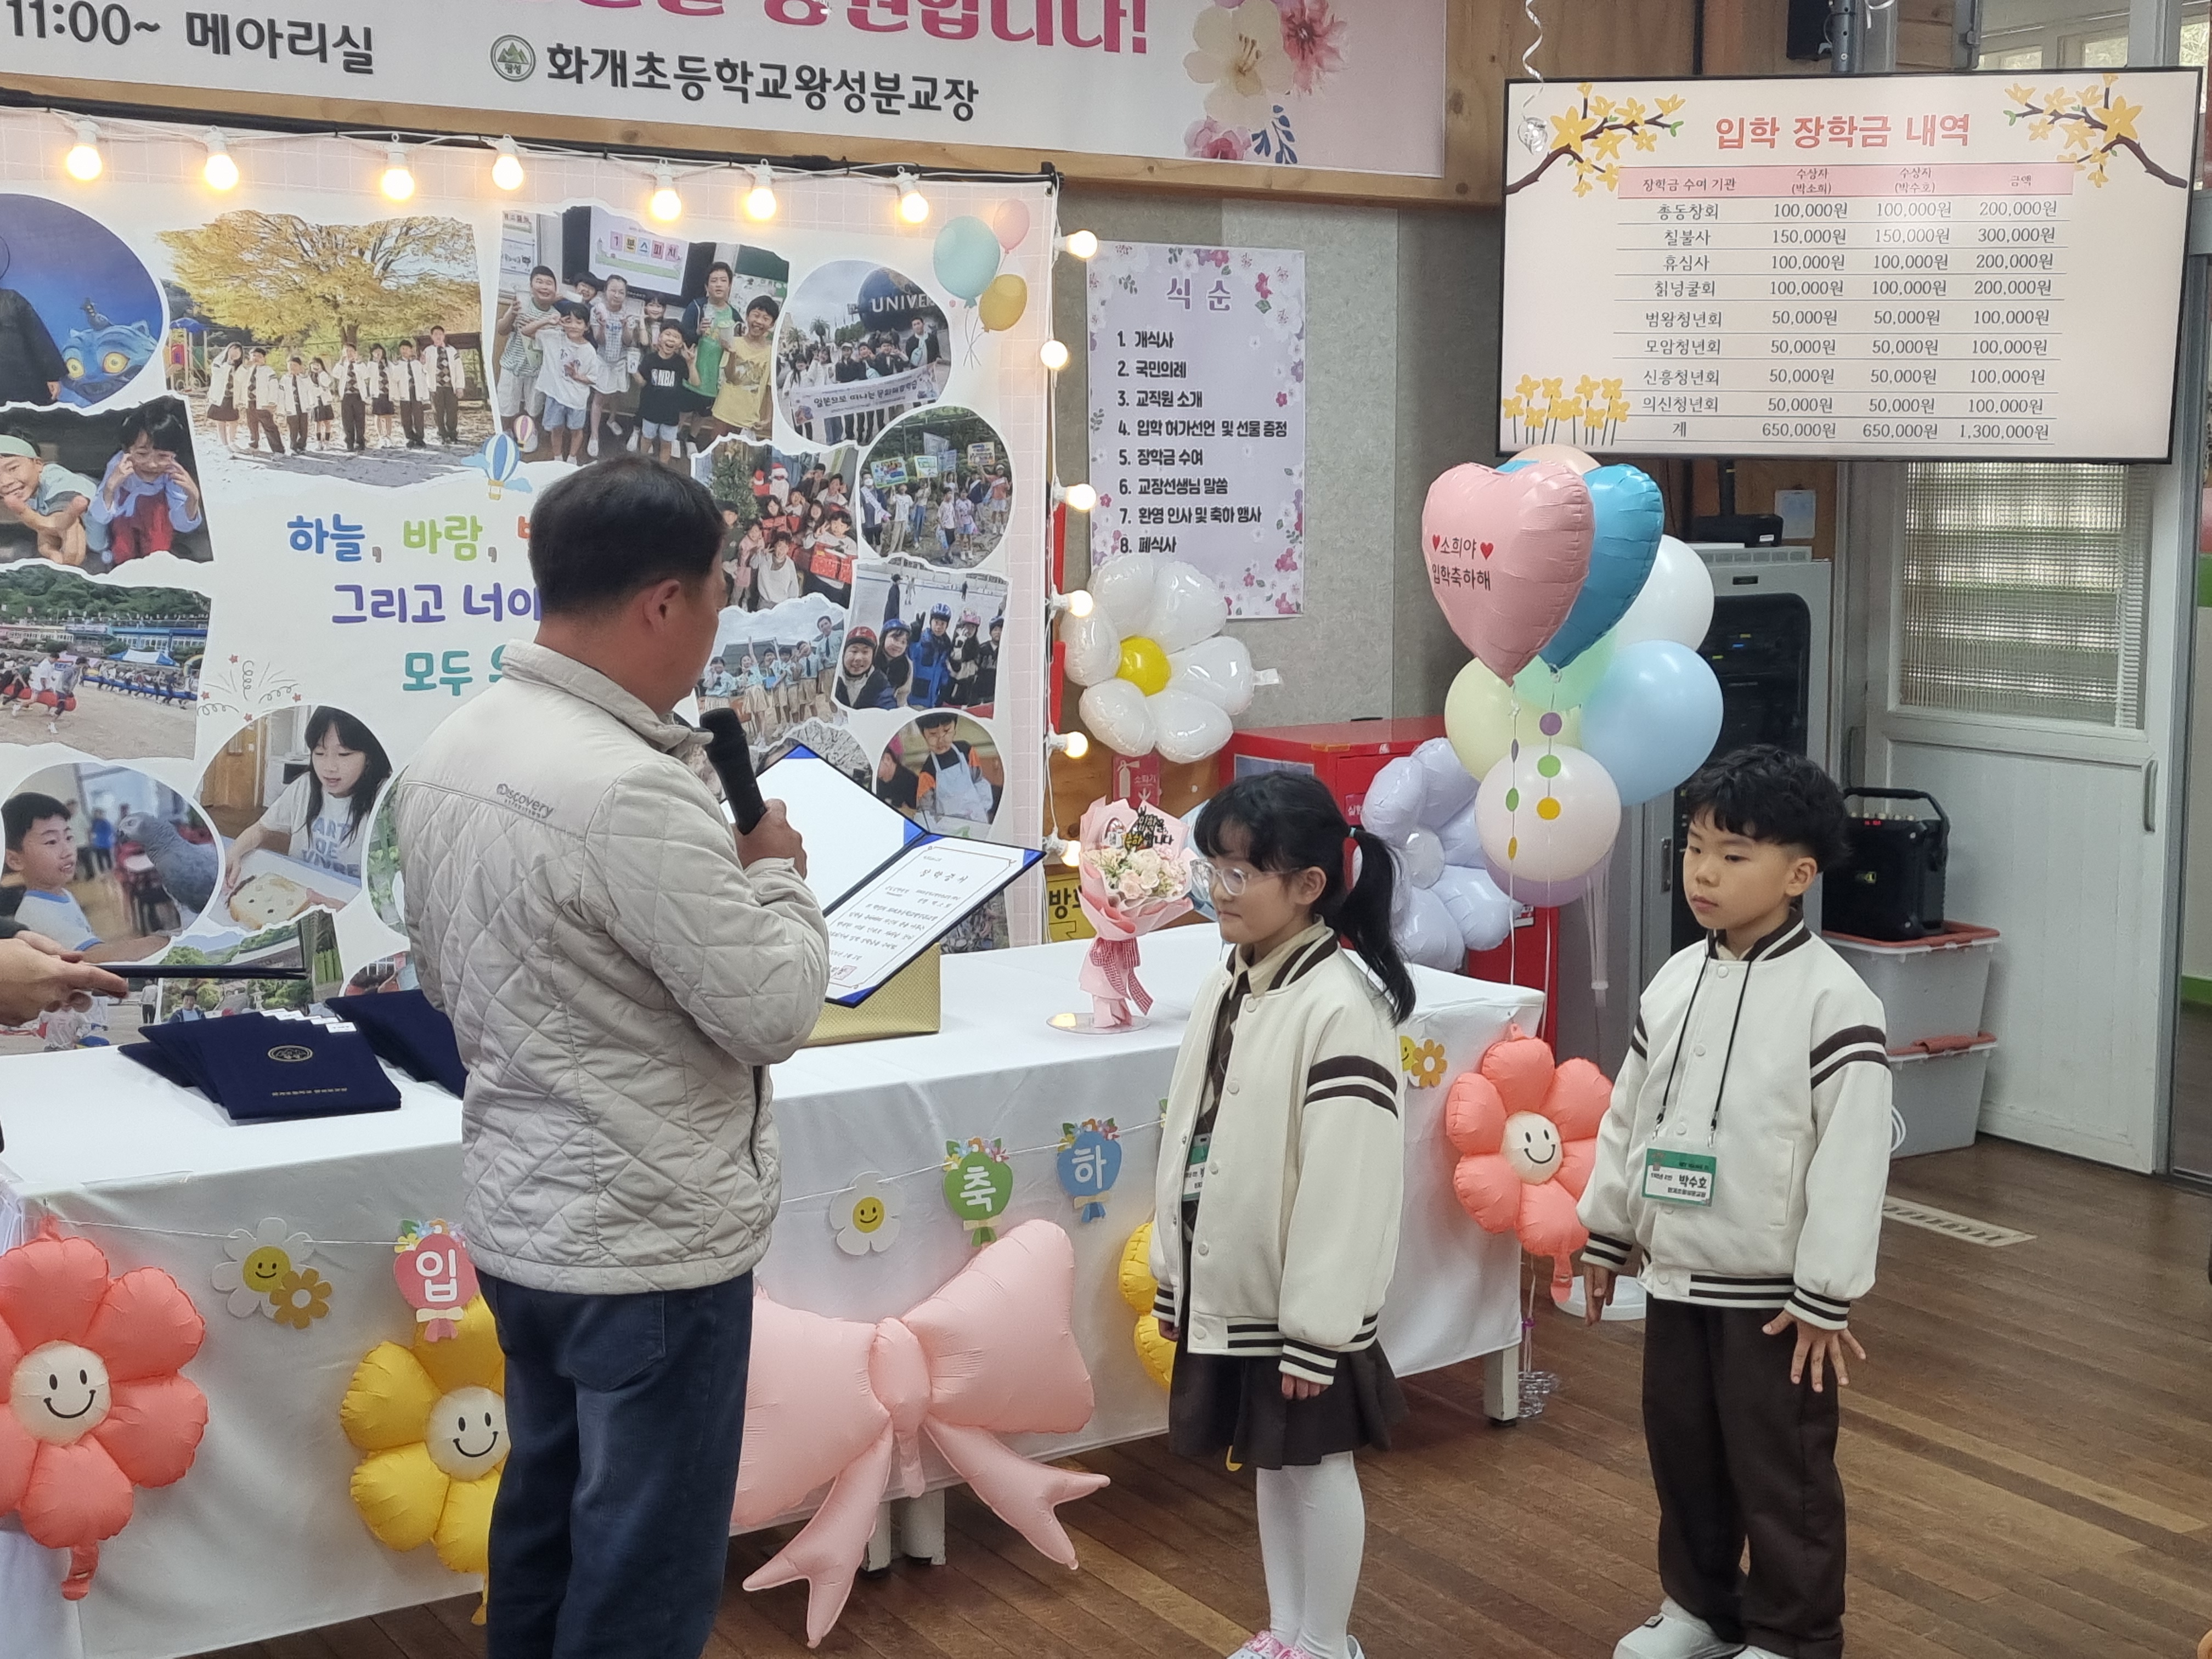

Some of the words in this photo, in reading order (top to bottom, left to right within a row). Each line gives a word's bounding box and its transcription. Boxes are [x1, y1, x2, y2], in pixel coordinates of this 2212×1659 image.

[186, 12, 373, 74] 메아리실
[547, 43, 979, 121] 화개초등학교왕성분교장
[1716, 116, 1779, 149] 입학
[1793, 115, 1891, 148] 장학금
[1906, 113, 1968, 146] 내역
[1797, 168, 1827, 179] 수상자
[1900, 167, 1931, 178] 수상자
[2012, 175, 2031, 186] 금액
[1643, 179, 1679, 191] 장학금
[1684, 178, 1706, 191] 수여
[1713, 178, 1735, 190] 기관
[1895, 182, 1935, 193] (박수호)
[1658, 204, 1718, 220] 총동창회
[1775, 202, 1847, 218] 100,000원
[1878, 202, 1951, 217] 100,000원
[1980, 201, 2056, 217] 200,000원
[1665, 230, 1711, 246] 칠불사
[1774, 229, 1846, 245] 150,000원
[1876, 228, 1949, 244] 150,000원
[1979, 227, 2055, 243] 300,000원
[1667, 255, 1708, 271] 휴심사
[1773, 255, 1844, 270] 100,000원
[1875, 254, 1948, 270] 100,000원
[1977, 253, 2052, 269] 200,000원
[1167, 279, 1190, 309] 식
[1208, 280, 1231, 311] 순
[1656, 281, 1714, 297] 칡넝쿨회
[1771, 280, 1843, 296] 100,000원
[1874, 280, 1946, 296] 100,000원
[1975, 280, 2051, 296] 200,000원
[1646, 312, 1721, 328] 범왕청년회
[1773, 310, 1837, 325] 50,000원
[1874, 310, 1939, 325] 50,000원
[1976, 309, 2049, 325] 100,000원
[1118, 331, 1125, 347] 1.
[1135, 331, 1173, 348] 개식사
[1647, 339, 1720, 355] 모암청년회
[1771, 340, 1835, 355] 50,000원
[1872, 340, 1938, 356] 50,000원
[1973, 340, 2047, 356] 100,000원
[1118, 360, 1129, 376] 2.
[1136, 360, 1186, 378] 국민의례
[1644, 370, 1719, 386] 신흥청년회
[1770, 369, 1833, 384] 50,000원
[1871, 369, 1936, 385] 50,000원
[1972, 370, 2045, 385] 100,000원
[1118, 391, 1129, 406] 3.
[1137, 391, 1173, 407] 교직원
[1177, 391, 1202, 408] 소개
[1644, 397, 1718, 413] 의신청년회
[1769, 398, 1832, 413] 50,000원
[1869, 398, 1934, 414] 50,000원
[1970, 399, 2042, 414] 100,000원
[1119, 420, 1130, 435] 4.
[1138, 420, 1163, 436] 입학
[1165, 420, 1215, 436] 허가선언
[1222, 421, 1233, 437] 및
[1237, 421, 1260, 437] 선물
[1264, 421, 1286, 437] 증정
[1673, 422, 1686, 437] 계
[1763, 423, 1836, 438] 650,000원
[1863, 424, 1937, 439] 650,000원
[1961, 425, 2048, 440] 1,300,000원
[1120, 449, 1130, 465] 5.
[1138, 449, 1175, 465] 장학금
[1179, 449, 1203, 465] 수여
[1120, 479, 1131, 494] 6.
[1138, 478, 1200, 495] 교장선생님
[1204, 478, 1227, 494] 말씀
[1120, 508, 1131, 524] 7.
[1139, 507, 1164, 524] 환영
[1168, 507, 1192, 523] 인사
[1195, 507, 1206, 523] 및
[1211, 507, 1234, 523] 축하
[1237, 506, 1261, 522] 행사
[287, 514, 381, 563] 하늘,
[403, 515, 497, 562] 바람,
[1120, 538, 1132, 553] 8.
[1440, 537, 1477, 560] 소희야
[1432, 563, 1491, 591] 입학축하해
[332, 585, 446, 623] 그리고
[403, 651, 473, 696] 모두
[960, 1166, 997, 1211] 축
[1071, 1146, 1107, 1189] 하
[1679, 1174, 1707, 1189] 박수호
[416, 1249, 457, 1302] 입
